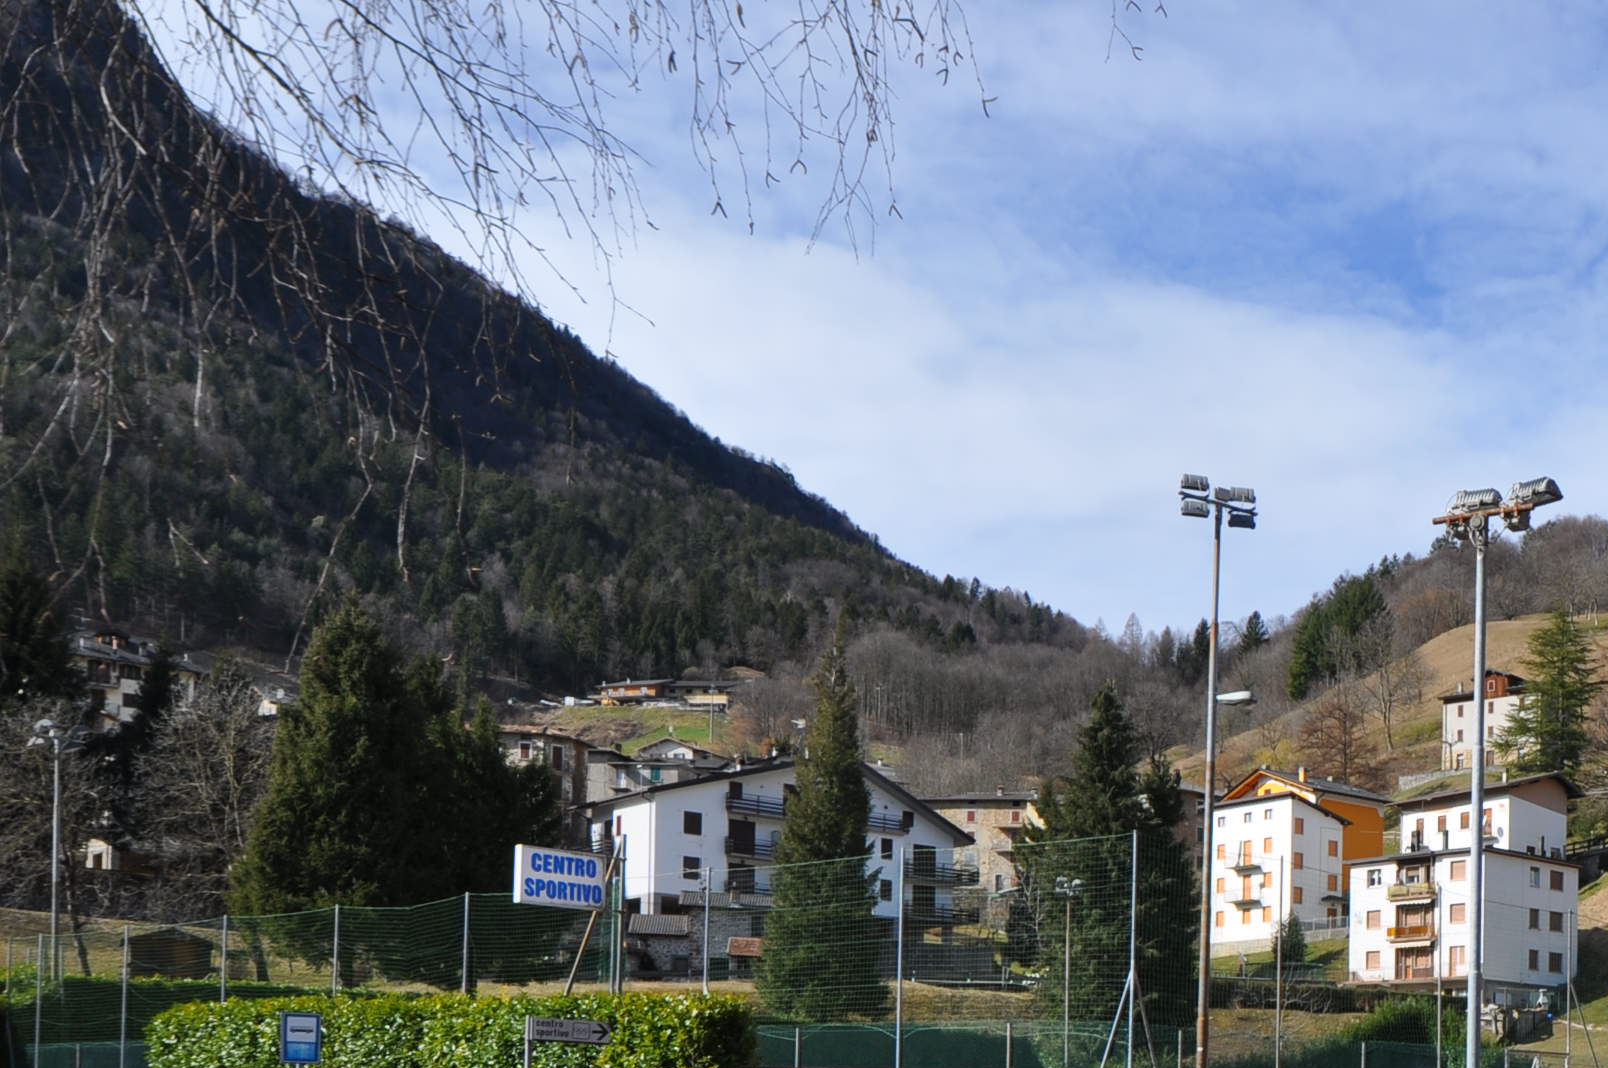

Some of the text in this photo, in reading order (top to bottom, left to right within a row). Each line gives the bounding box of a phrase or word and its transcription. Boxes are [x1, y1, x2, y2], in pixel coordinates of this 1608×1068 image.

[531, 852, 597, 879] CENTRO
[524, 877, 603, 905] SPORTIVO
[536, 1020, 563, 1028] centro
[536, 1029, 570, 1038] sportivo
